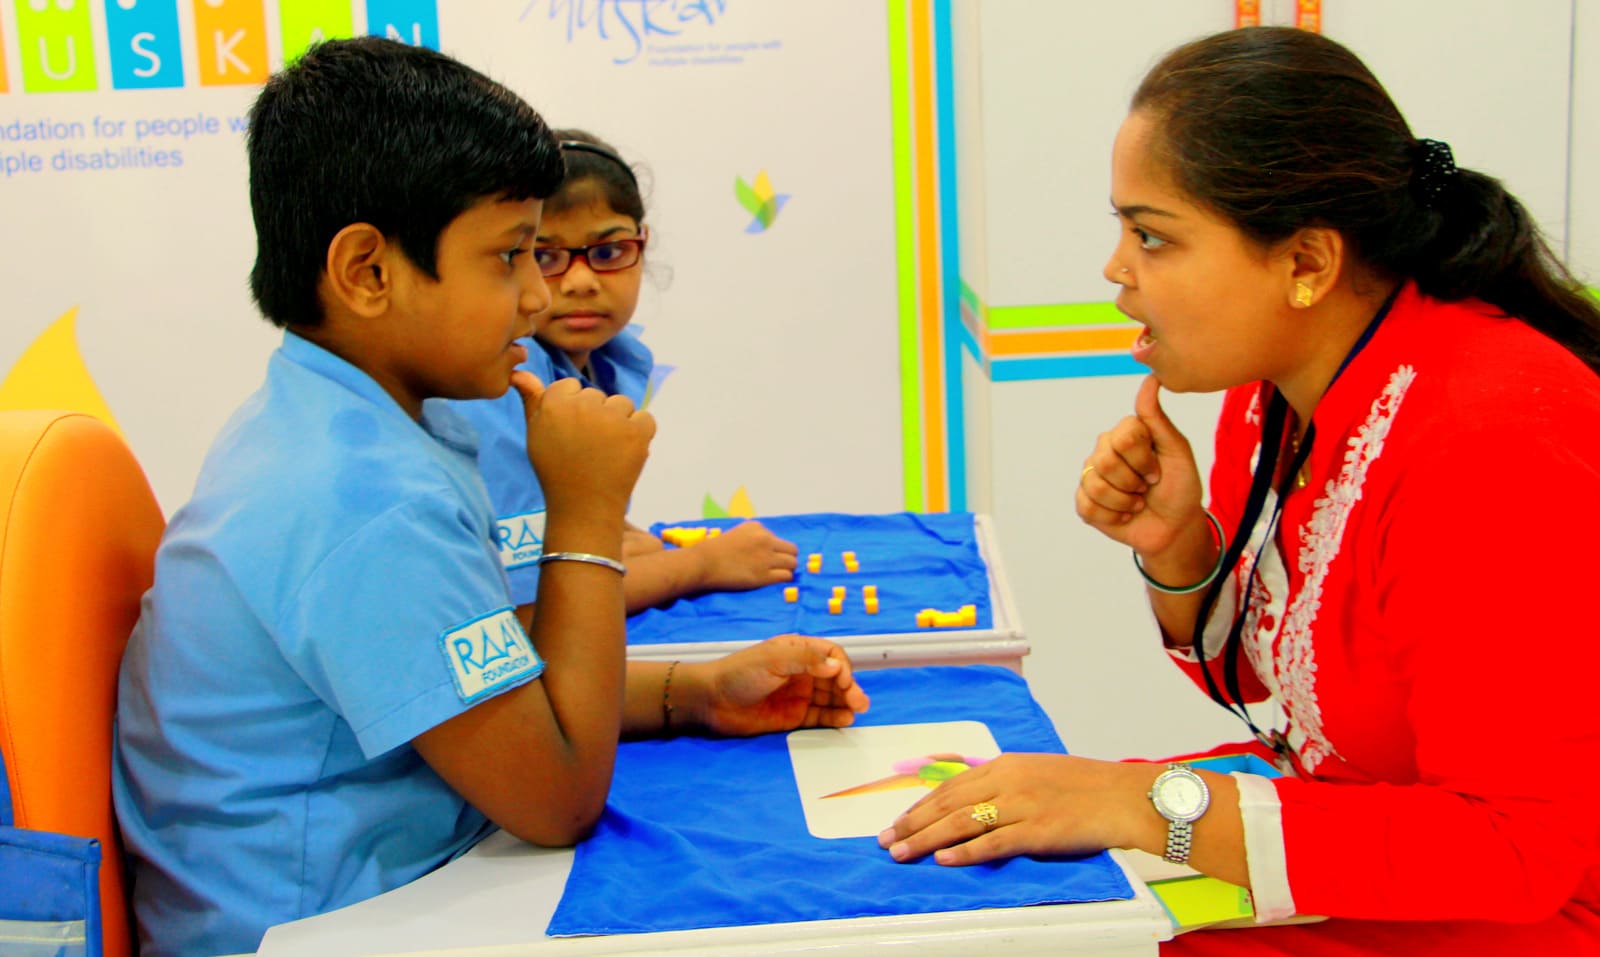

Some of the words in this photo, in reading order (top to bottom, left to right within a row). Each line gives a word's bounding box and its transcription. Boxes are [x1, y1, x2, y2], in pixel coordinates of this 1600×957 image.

[93, 114, 127, 138] for
[135, 112, 220, 142] people
[51, 146, 184, 171] disabilities
